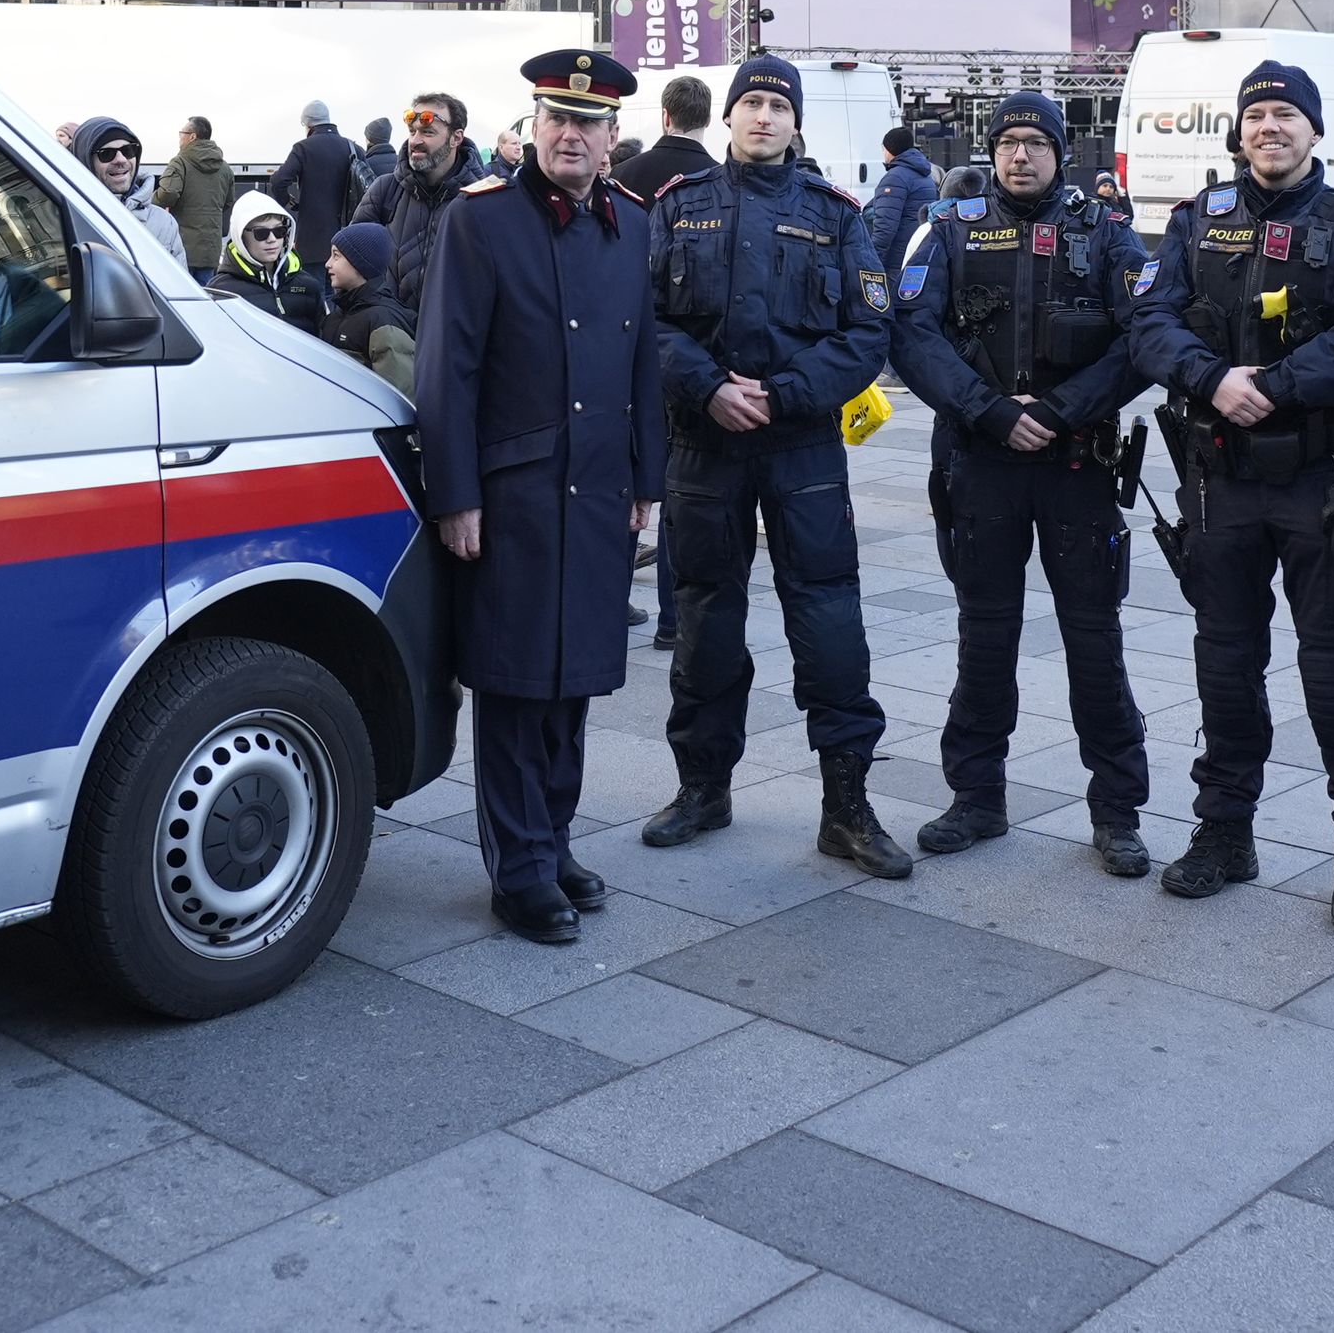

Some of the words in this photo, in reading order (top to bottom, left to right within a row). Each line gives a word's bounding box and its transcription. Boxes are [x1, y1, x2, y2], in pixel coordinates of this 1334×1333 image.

[750, 75, 781, 84] POLIZEI
[1003, 112, 1041, 122] POLIZEI
[1136, 103, 1234, 135] redlin
[969, 229, 1017, 241] POLIZEI
[1207, 228, 1254, 241] POLIZEI
[861, 273, 884, 283] POLIZEI
